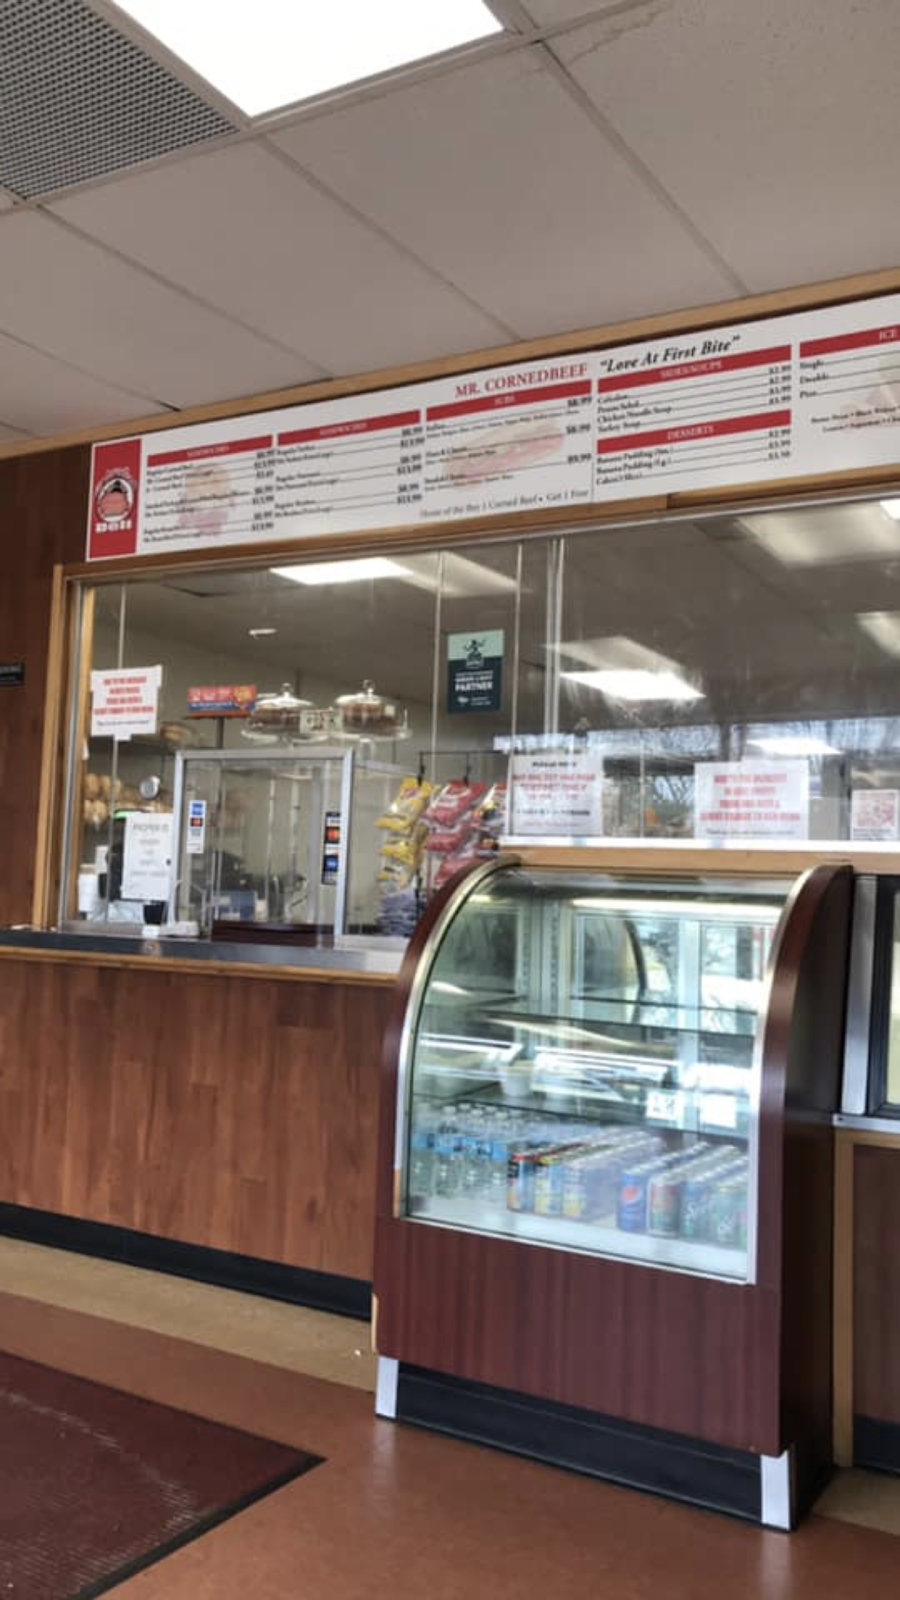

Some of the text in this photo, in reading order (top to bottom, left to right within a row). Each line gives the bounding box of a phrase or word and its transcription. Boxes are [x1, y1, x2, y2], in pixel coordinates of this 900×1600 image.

[640, 352, 659, 366] At
[661, 344, 697, 363] First
[455, 362, 588, 398] MR. CORNEDBEEF
